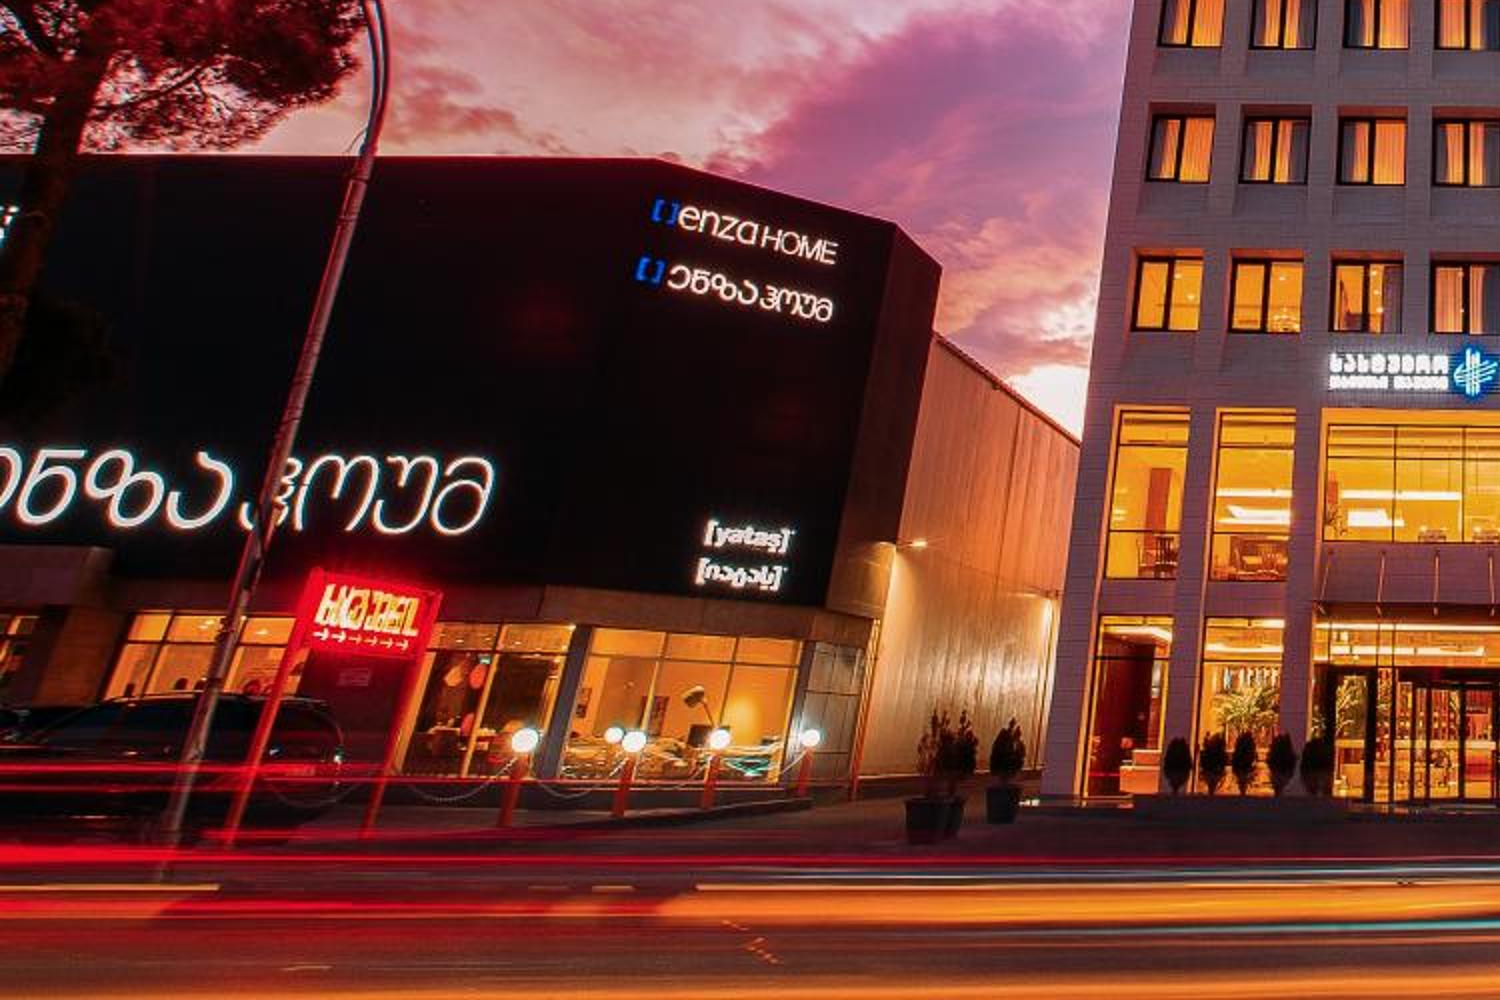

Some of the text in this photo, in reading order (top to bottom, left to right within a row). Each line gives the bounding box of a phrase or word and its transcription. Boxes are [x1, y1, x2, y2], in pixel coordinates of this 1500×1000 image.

[678, 206, 839, 264] enza HOME
[667, 265, 833, 322] ენზა ჰოუმ
